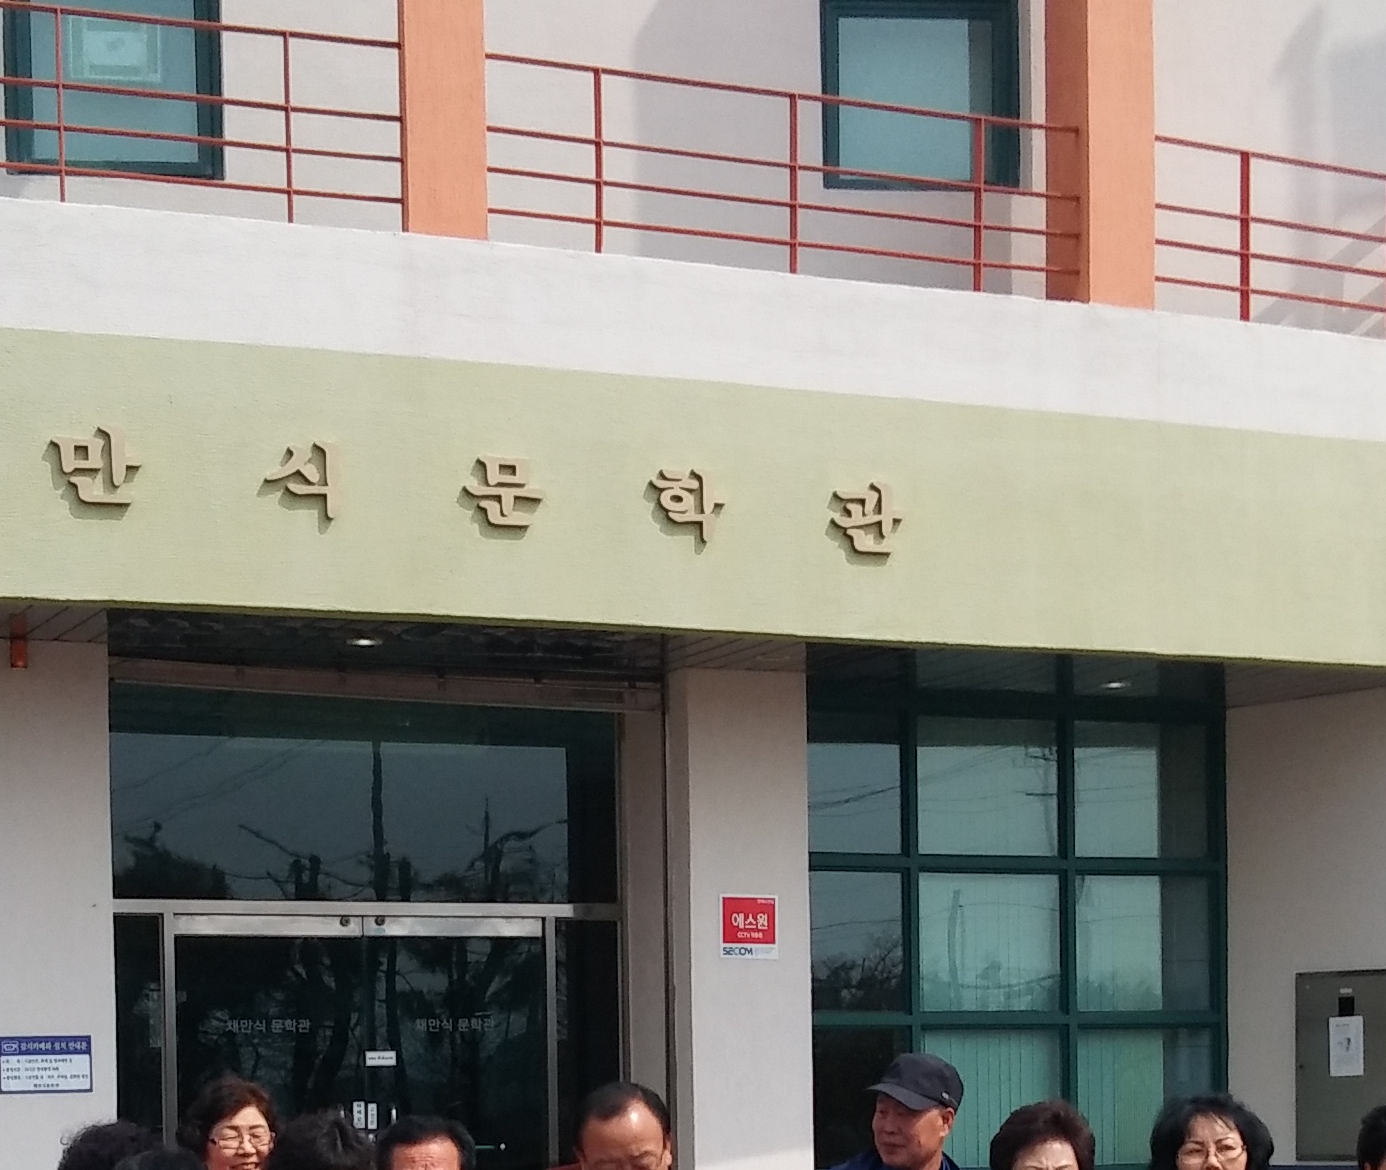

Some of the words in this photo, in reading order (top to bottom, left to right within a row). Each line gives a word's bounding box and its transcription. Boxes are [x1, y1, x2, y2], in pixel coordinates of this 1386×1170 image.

[731, 911, 768, 930] 에스원
[225, 1018, 266, 1034] 채만식
[270, 1018, 311, 1034] 문학관
[415, 1017, 454, 1033] 채만식
[458, 1017, 495, 1032] 문학관
